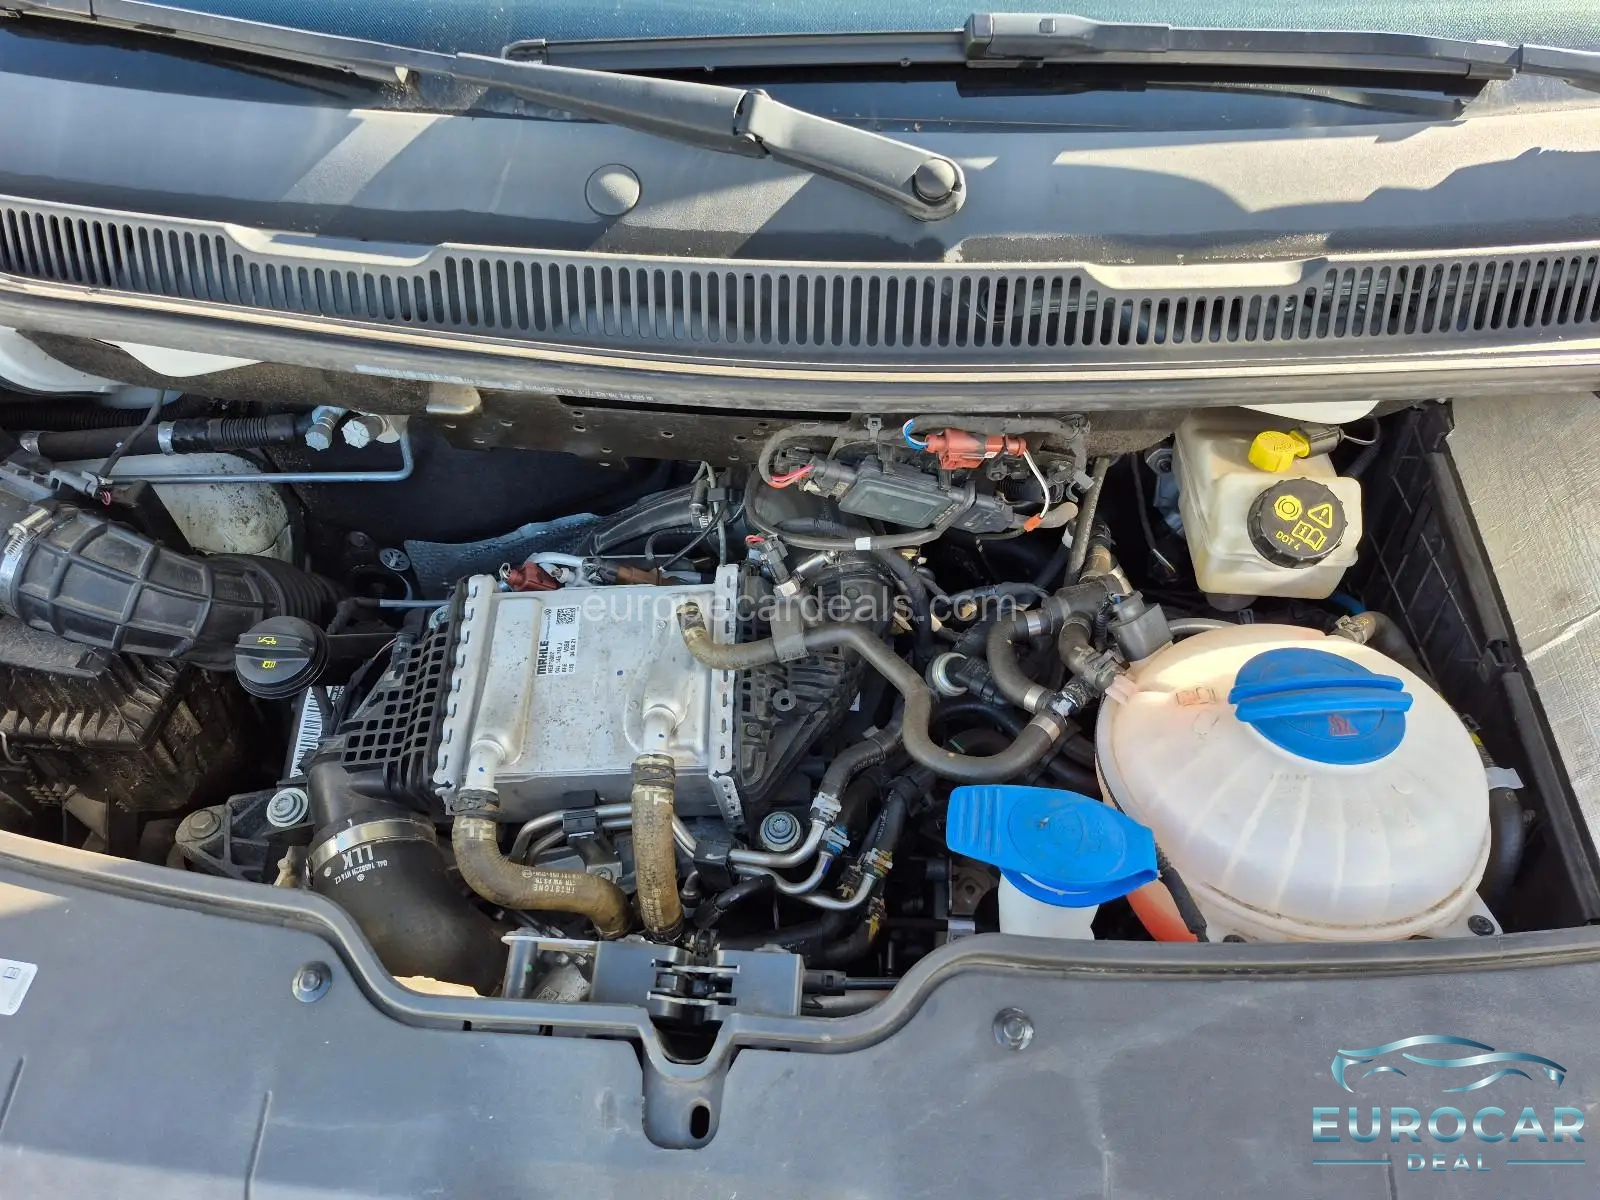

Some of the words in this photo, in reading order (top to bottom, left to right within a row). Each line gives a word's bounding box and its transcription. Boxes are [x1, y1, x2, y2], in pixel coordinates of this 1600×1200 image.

[1276, 530, 1294, 545] DOT
[537, 640, 549, 675] MAHLE
[342, 844, 373, 870] LLK
